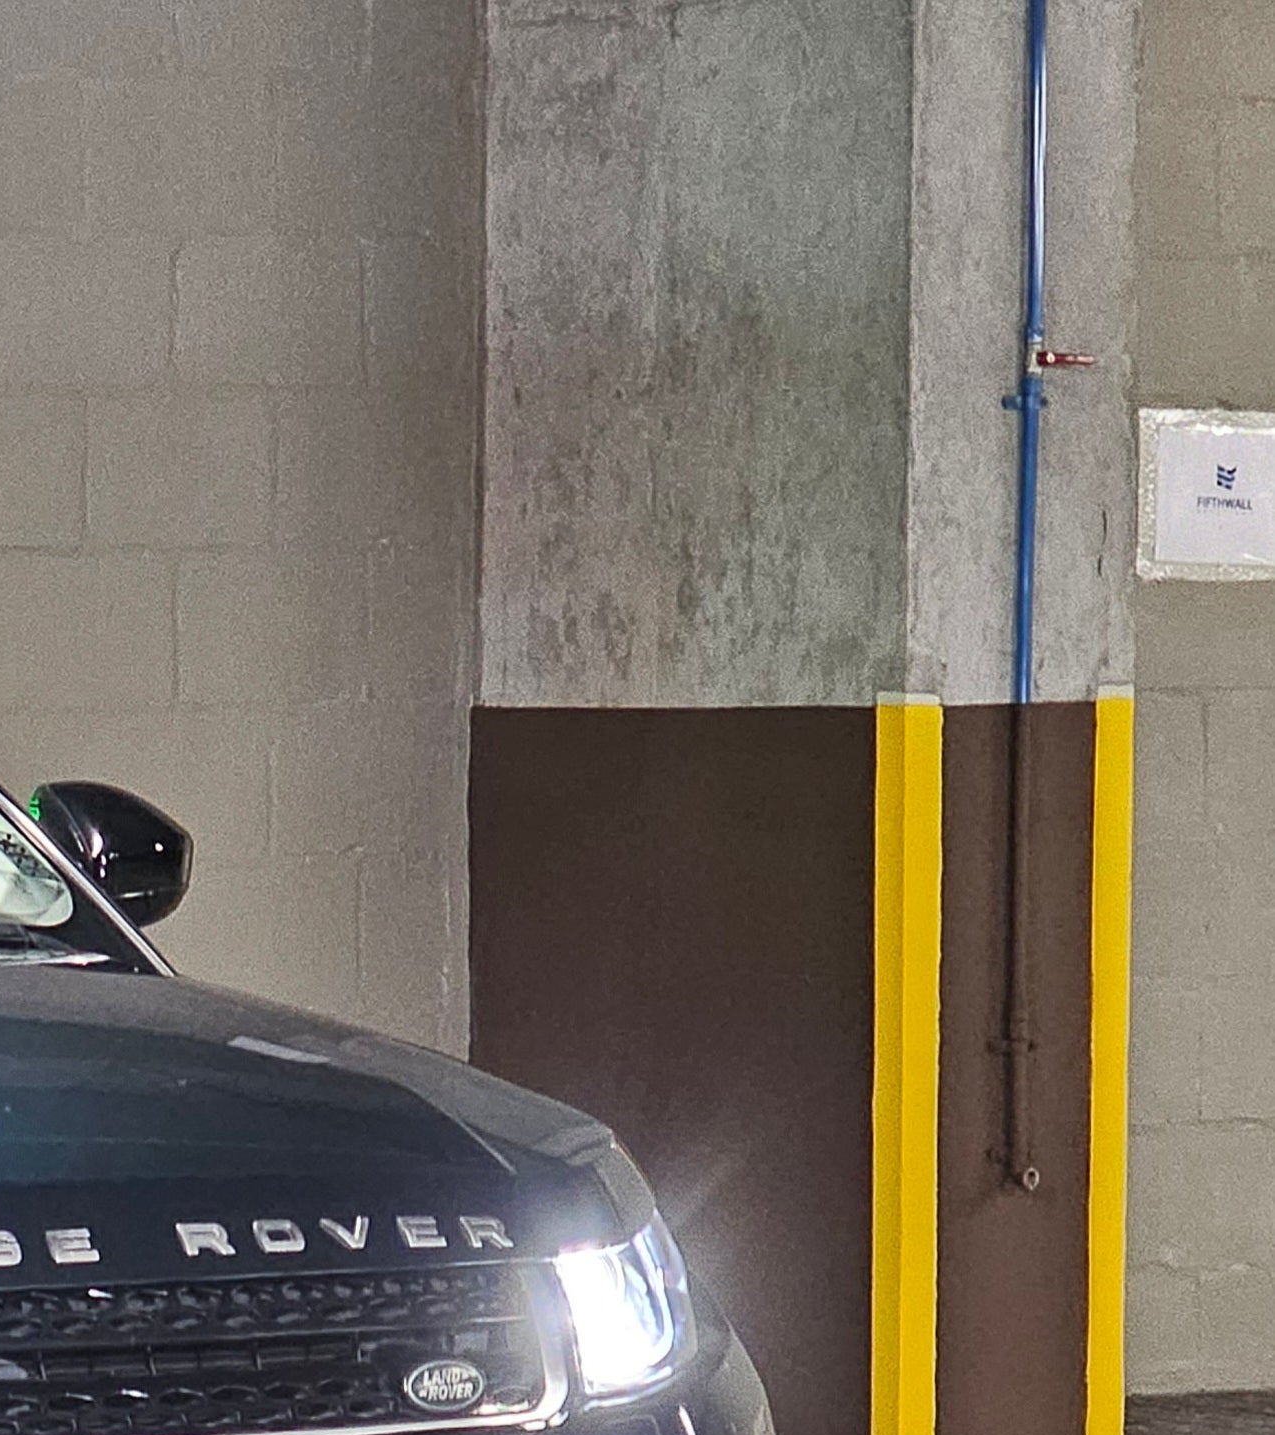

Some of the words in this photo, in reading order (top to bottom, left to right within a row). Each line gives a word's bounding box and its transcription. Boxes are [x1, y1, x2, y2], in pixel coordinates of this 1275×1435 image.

[1197, 496, 1253, 510] FIFTHWALL
[174, 1214, 516, 1257] ROVER
[423, 1367, 462, 1387] LAND
[428, 1382, 474, 1401] ROVER
